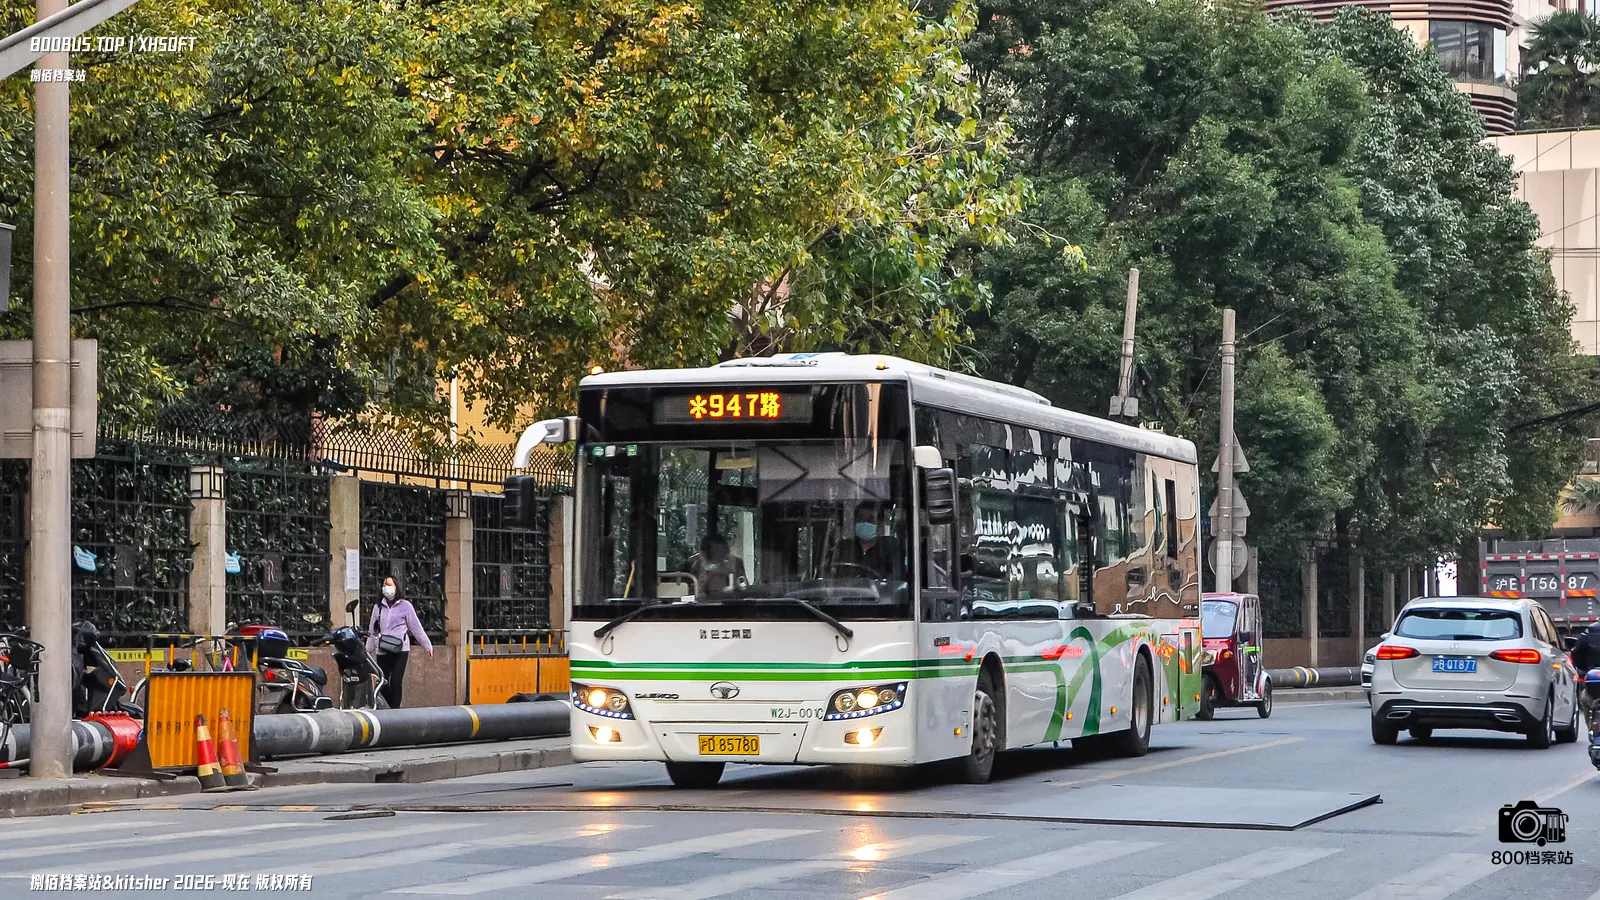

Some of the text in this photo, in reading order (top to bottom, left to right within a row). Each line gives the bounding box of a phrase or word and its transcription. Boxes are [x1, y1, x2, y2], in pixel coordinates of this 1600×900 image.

[1495, 576, 1588, 591] 沪E T56 87
